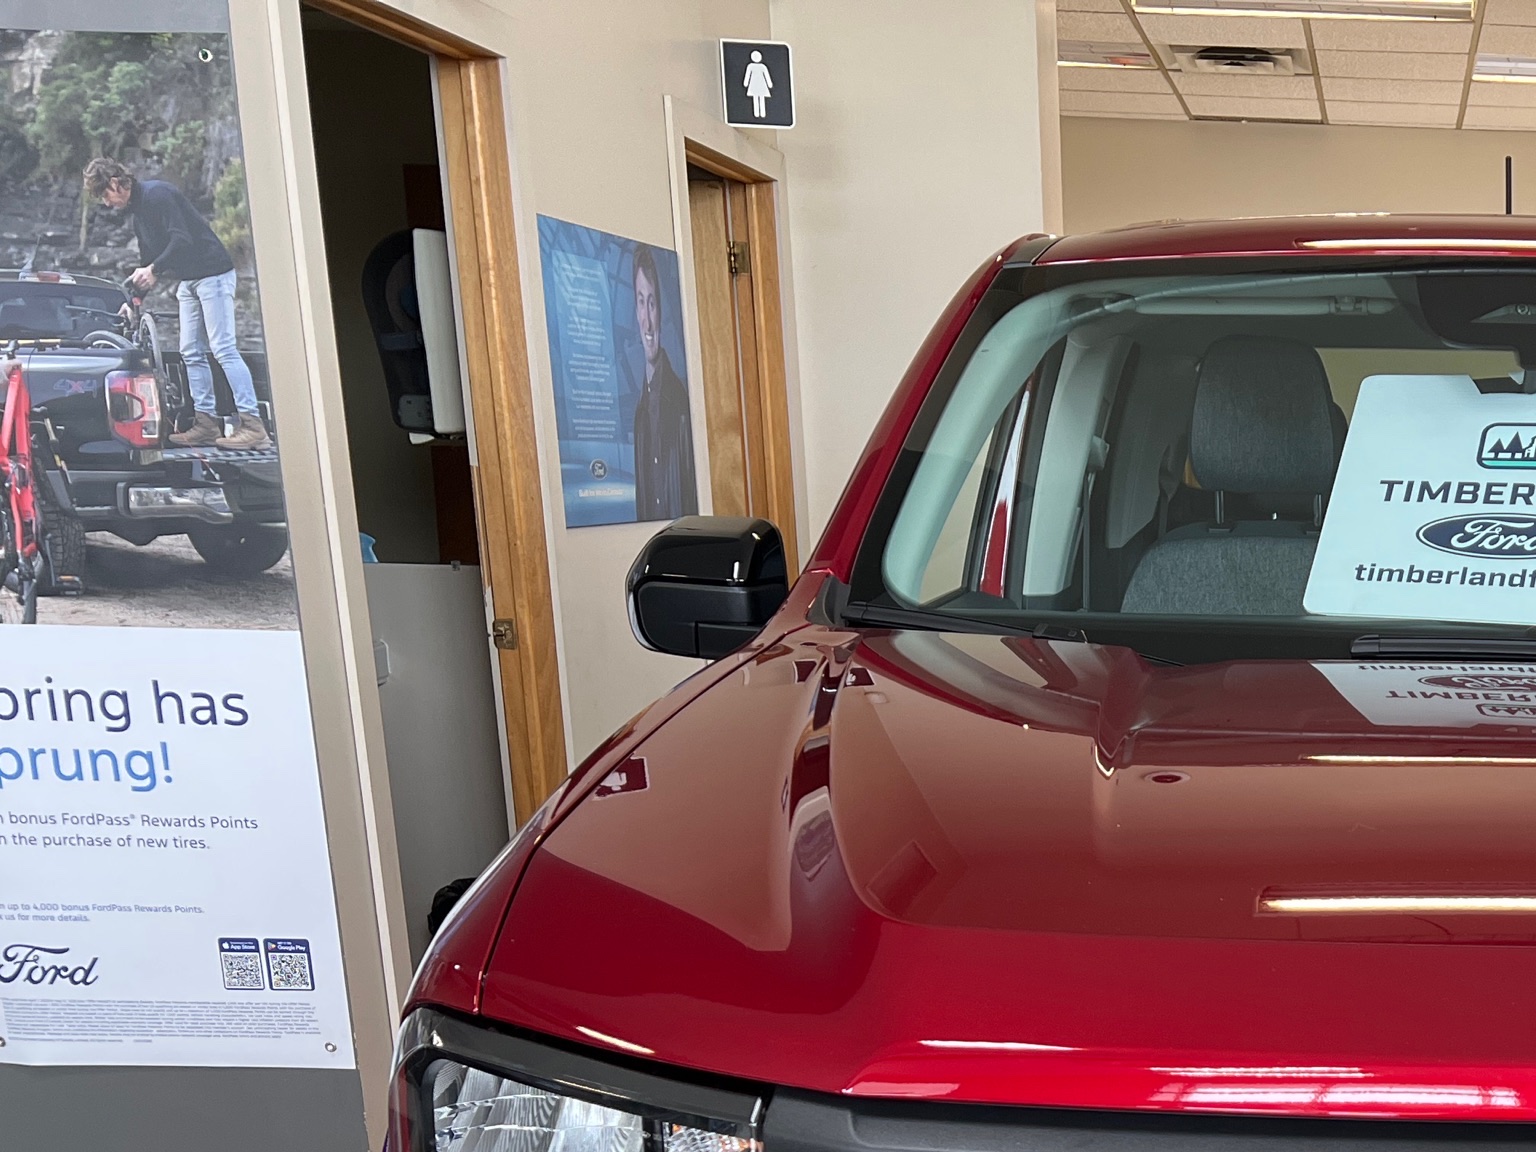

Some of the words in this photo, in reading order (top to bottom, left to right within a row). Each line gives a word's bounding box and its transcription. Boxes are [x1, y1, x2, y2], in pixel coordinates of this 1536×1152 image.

[151, 680, 249, 726] has
[8, 811, 57, 825] bonus
[140, 814, 206, 828] Rewards
[210, 816, 258, 829] Points
[12, 832, 37, 846] the
[42, 834, 112, 848] purchase
[117, 834, 132, 847] of
[137, 837, 168, 848] new
[172, 836, 211, 849] tires.
[7, 903, 19, 911] up
[21, 903, 31, 911] to
[61, 903, 90, 912] bonus
[92, 903, 132, 912] FordPass
[134, 904, 172, 913] Rewards
[17, 913, 30, 921] for
[32, 914, 55, 922] more
[0, 943, 99, 986] Ford
